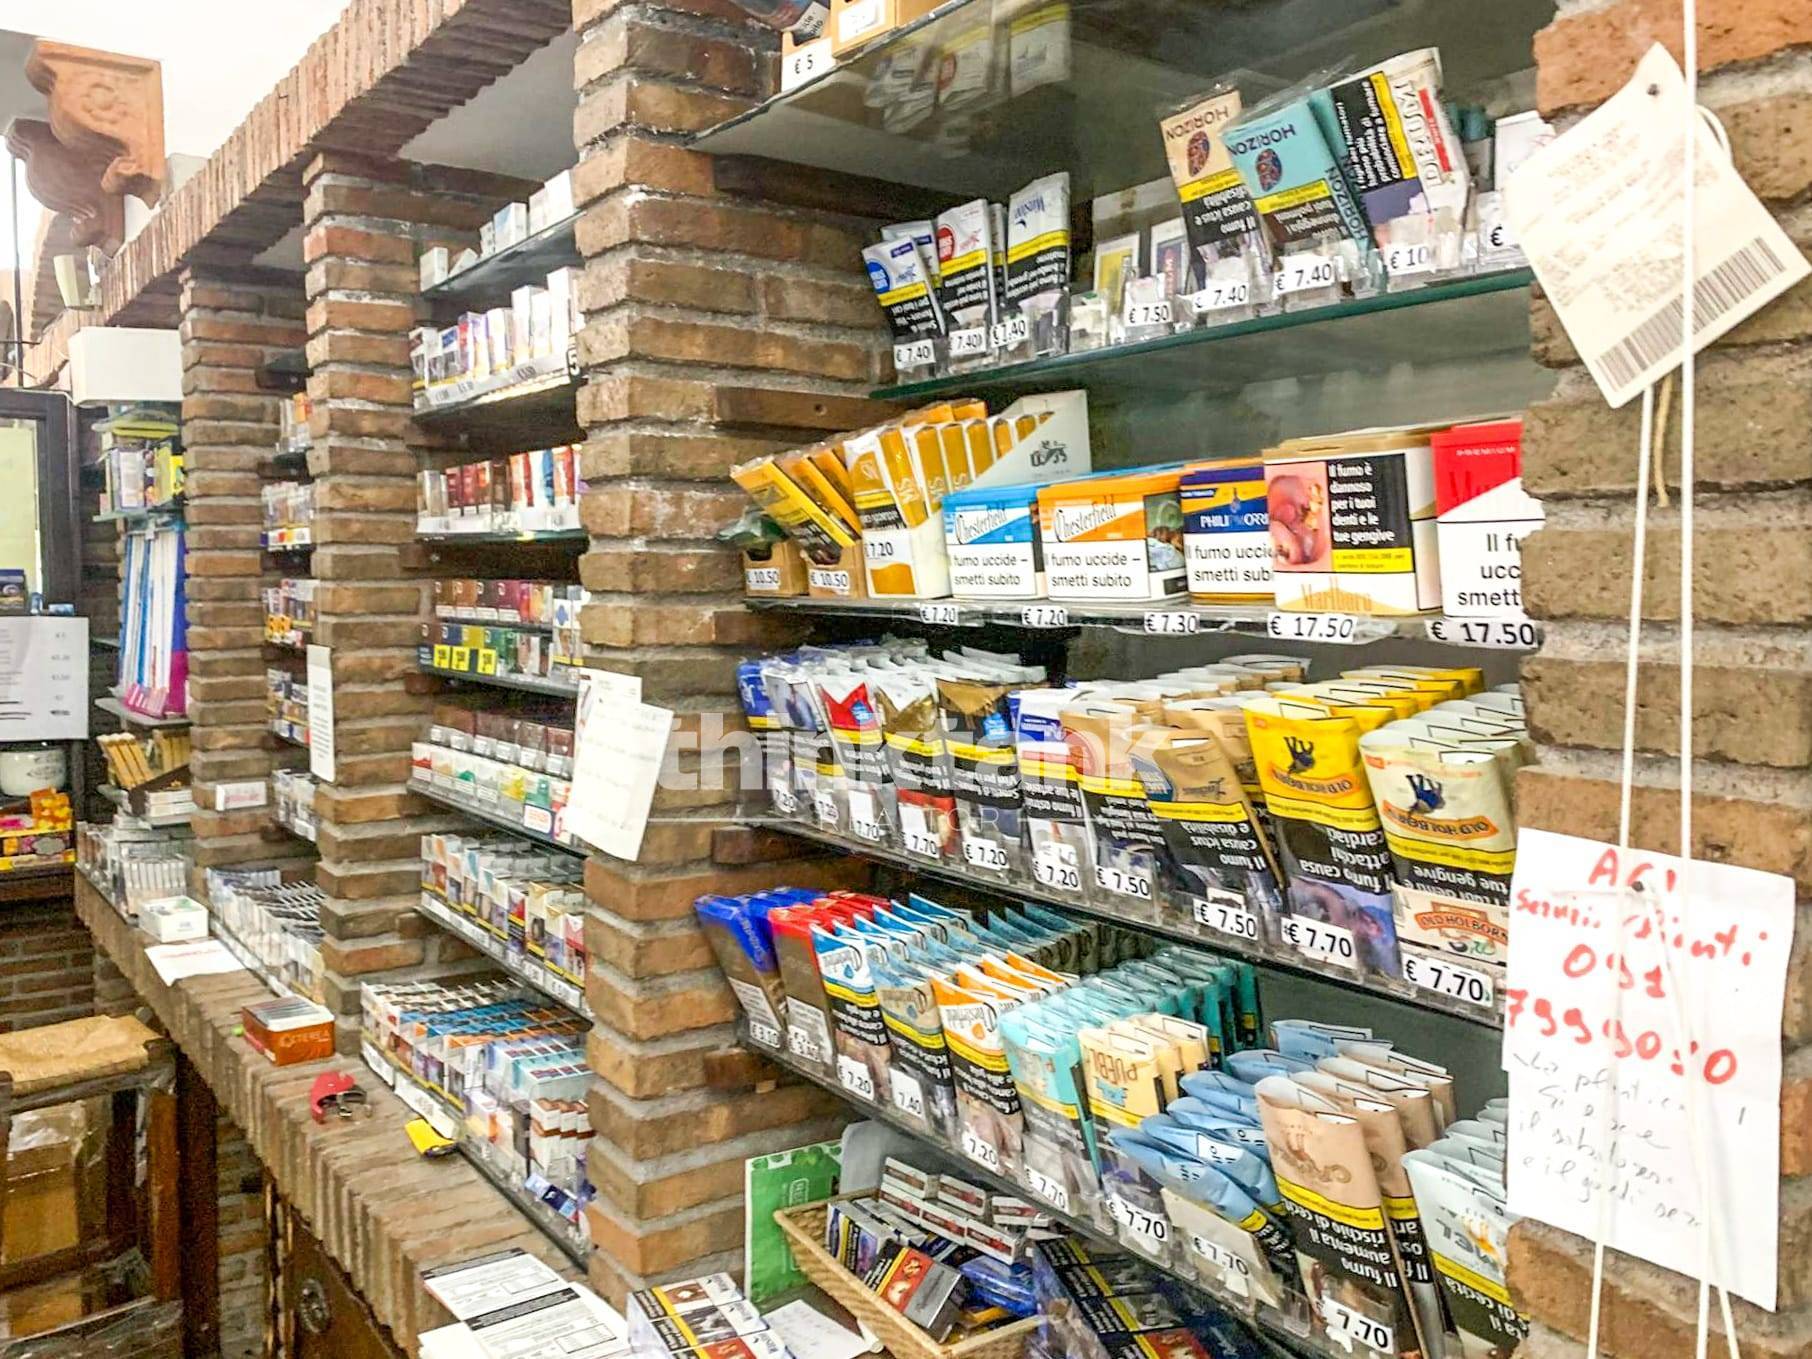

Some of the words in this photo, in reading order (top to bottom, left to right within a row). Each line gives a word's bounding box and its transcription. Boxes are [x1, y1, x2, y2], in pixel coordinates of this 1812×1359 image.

[1361, 80, 1380, 118] fumare
[1166, 105, 1229, 141] HORIZON
[1335, 102, 1354, 146] fumatori
[1227, 123, 1296, 156] HORIZON
[1395, 80, 1445, 188] DRUM
[1363, 128, 1392, 182] probabilità
[1377, 125, 1401, 179] cominciare
[1360, 154, 1378, 187] hanno
[1222, 200, 1252, 217] causa
[1326, 166, 1369, 241] HORIZON
[1220, 218, 1247, 234] fumo
[1490, 226, 1504, 246] €
[1391, 254, 1400, 269] €
[1406, 246, 1428, 267] 10
[1274, 272, 1286, 290] €
[1295, 261, 1333, 285] 7.40
[1213, 284, 1247, 305] 7.40
[1128, 309, 1137, 324] €
[1143, 303, 1170, 322] 7.50
[906, 345, 930, 360] 7.40
[1337, 463, 1365, 477] fumo
[1329, 481, 1373, 494] dannoso
[1331, 499, 1349, 513] per
[1355, 496, 1377, 510] tuoi
[954, 504, 1008, 545] Chesterfield
[1055, 499, 1118, 543] Chesterfield
[1200, 513, 1232, 528] PHILI
[1238, 512, 1269, 527] ORRI
[1331, 513, 1358, 526] denti
[1367, 512, 1380, 526] le
[1333, 531, 1350, 543] tue
[1350, 529, 1396, 545] gengive
[1485, 532, 1499, 552] Il
[870, 542, 894, 558] 7.20
[954, 553, 979, 567] fumo
[983, 552, 1017, 567] uccide
[1052, 552, 1082, 567] fumo
[1085, 552, 1128, 567] uccide
[1195, 545, 1231, 559] fumo
[1236, 543, 1273, 559] ucci
[822, 571, 849, 587] 10.50
[954, 572, 985, 586] smetti
[988, 572, 1021, 586] subito
[1052, 572, 1089, 587] smetti
[1092, 572, 1132, 588] subito
[1195, 567, 1239, 581] smetti
[1243, 566, 1271, 581] sub
[1480, 566, 1521, 580] ucc
[1457, 590, 1520, 607] smett
[932, 607, 957, 624] 7.20
[1037, 609, 1065, 627] 7.20
[1147, 615, 1158, 631] €
[1162, 615, 1198, 635] 7.30
[1269, 616, 1282, 637] €
[1295, 617, 1354, 639] 17.50
[1431, 622, 1449, 642] €
[1463, 623, 1535, 647] 17.50
[1180, 821, 1240, 835] disabilità
[1239, 823, 1250, 835] e
[1459, 820, 1490, 835] OLD
[911, 835, 938, 855] 7.70
[1191, 835, 1223, 850] ictus
[1222, 836, 1259, 851] causa
[1330, 827, 1387, 850] cardiaci
[979, 844, 1008, 867] 7.20
[1219, 854, 1257, 870] fumo
[1331, 848, 1391, 870] attacchi
[1046, 865, 1079, 888] 7.20
[1299, 859, 1344, 880] causa
[1411, 864, 1478, 888] gengive
[1112, 872, 1150, 897] 7.50
[1346, 868, 1386, 895] fumo
[1480, 876, 1510, 895] tue
[1198, 905, 1209, 923] €
[1218, 910, 1257, 938] 7.50
[1419, 911, 1446, 930] OLD
[1288, 923, 1301, 944] €
[1305, 928, 1352, 958] 7.70
[1404, 960, 1418, 982] €
[1429, 966, 1485, 1001] 7.70
[945, 1001, 998, 1033] Chesterfield
[1089, 1048, 1138, 1085] PUEBL
[970, 1138, 997, 1165] 7.20
[1126, 1207, 1165, 1240] 7.70
[1315, 1215, 1331, 1230] di
[1309, 1228, 1320, 1243] il
[1332, 1222, 1385, 1247] rischio
[1435, 1218, 1499, 1270] MEL
[1321, 1232, 1391, 1264] aumenta
[1209, 1243, 1250, 1275] 7.70
[1341, 1257, 1382, 1285] fumo
[1384, 1272, 1398, 1288] Il
[1416, 1262, 1428, 1280] Il
[1444, 1276, 1495, 1309] cecità
[1498, 1303, 1516, 1320] di
[1337, 1311, 1389, 1349] 7.70
[1489, 1314, 1502, 1332] il
